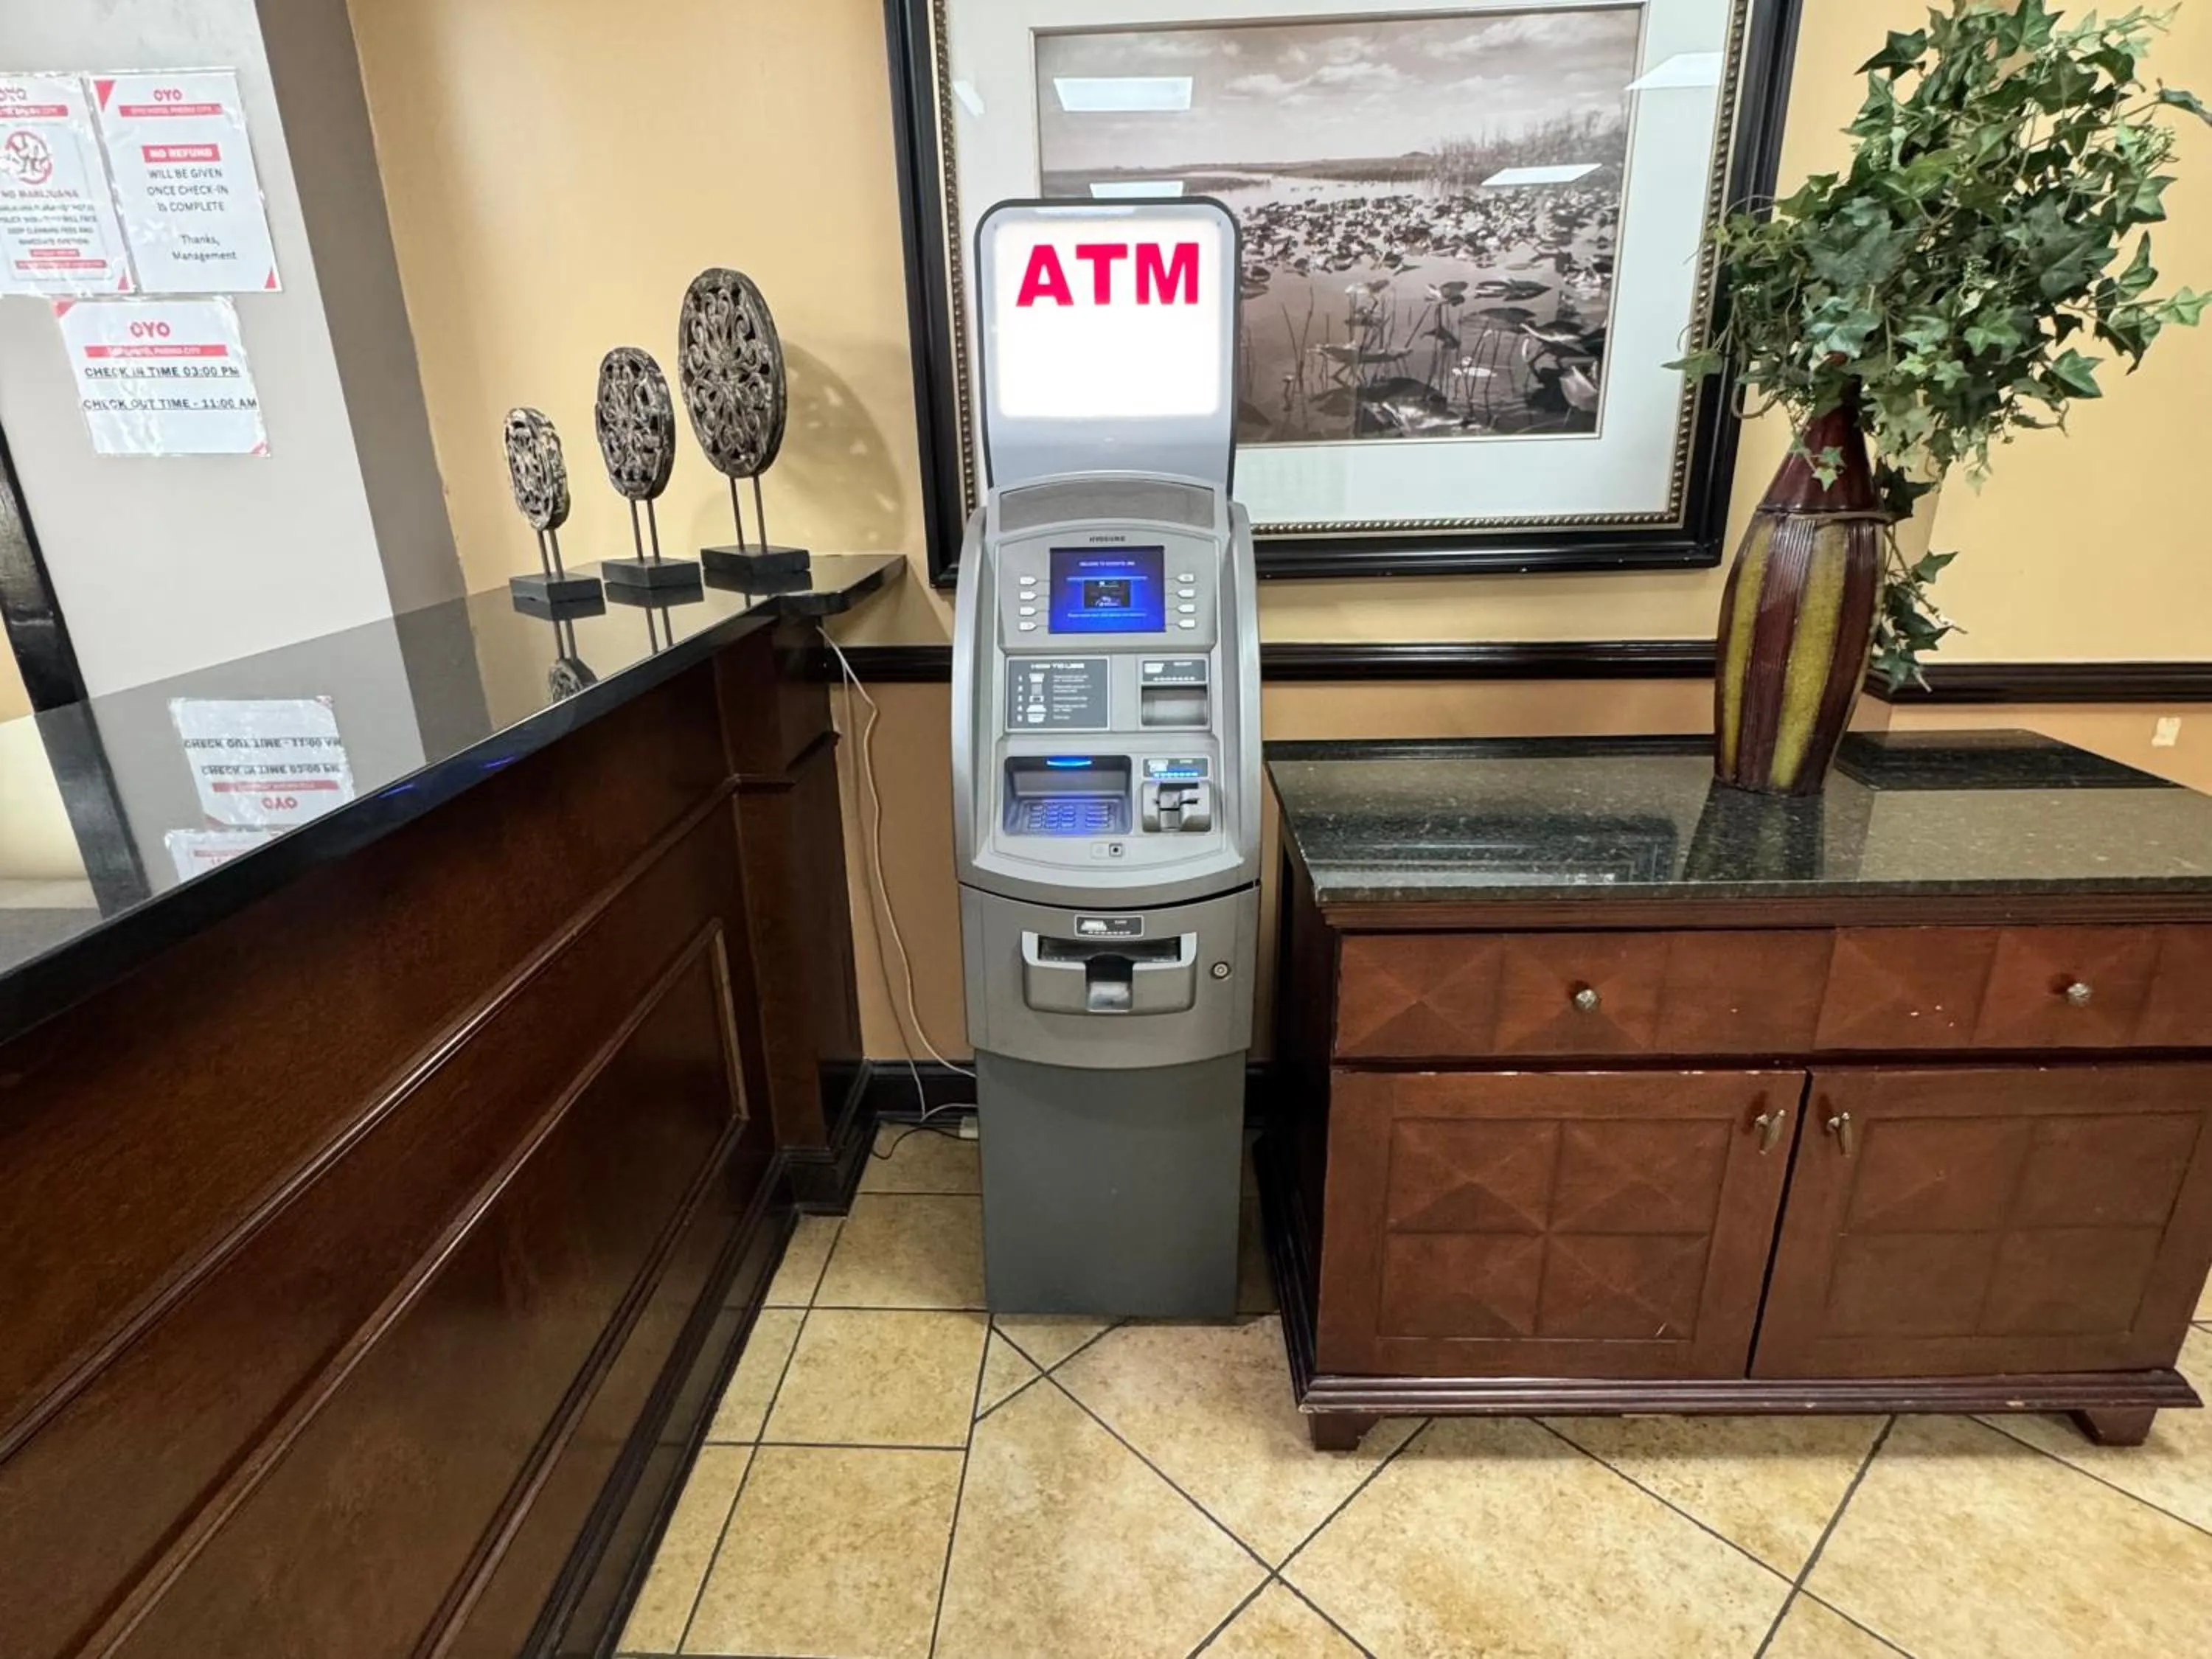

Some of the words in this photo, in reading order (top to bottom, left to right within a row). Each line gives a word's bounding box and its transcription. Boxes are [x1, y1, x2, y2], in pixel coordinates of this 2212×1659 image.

[153, 89, 183, 101] OYO
[150, 149, 167, 158] NO
[169, 147, 213, 158] REFUND
[149, 169, 173, 179] WILL
[175, 169, 189, 178] BE
[190, 168, 223, 178] GIVEN
[147, 187, 175, 196] ONCE
[178, 185, 229, 195] CHECK-IN
[170, 201, 226, 212] COMPLETE
[172, 250, 238, 262] Management
[1016, 242, 1199, 307] ATM
[130, 321, 170, 338] OYO
[84, 367, 126, 378] CHECK
[149, 367, 179, 378] TIME
[183, 366, 218, 377] 03:00
[221, 366, 240, 377] PM
[130, 399, 154, 410] OUT
[160, 399, 192, 409] TIME
[201, 399, 234, 408] 11:00
[239, 398, 257, 408] AM
